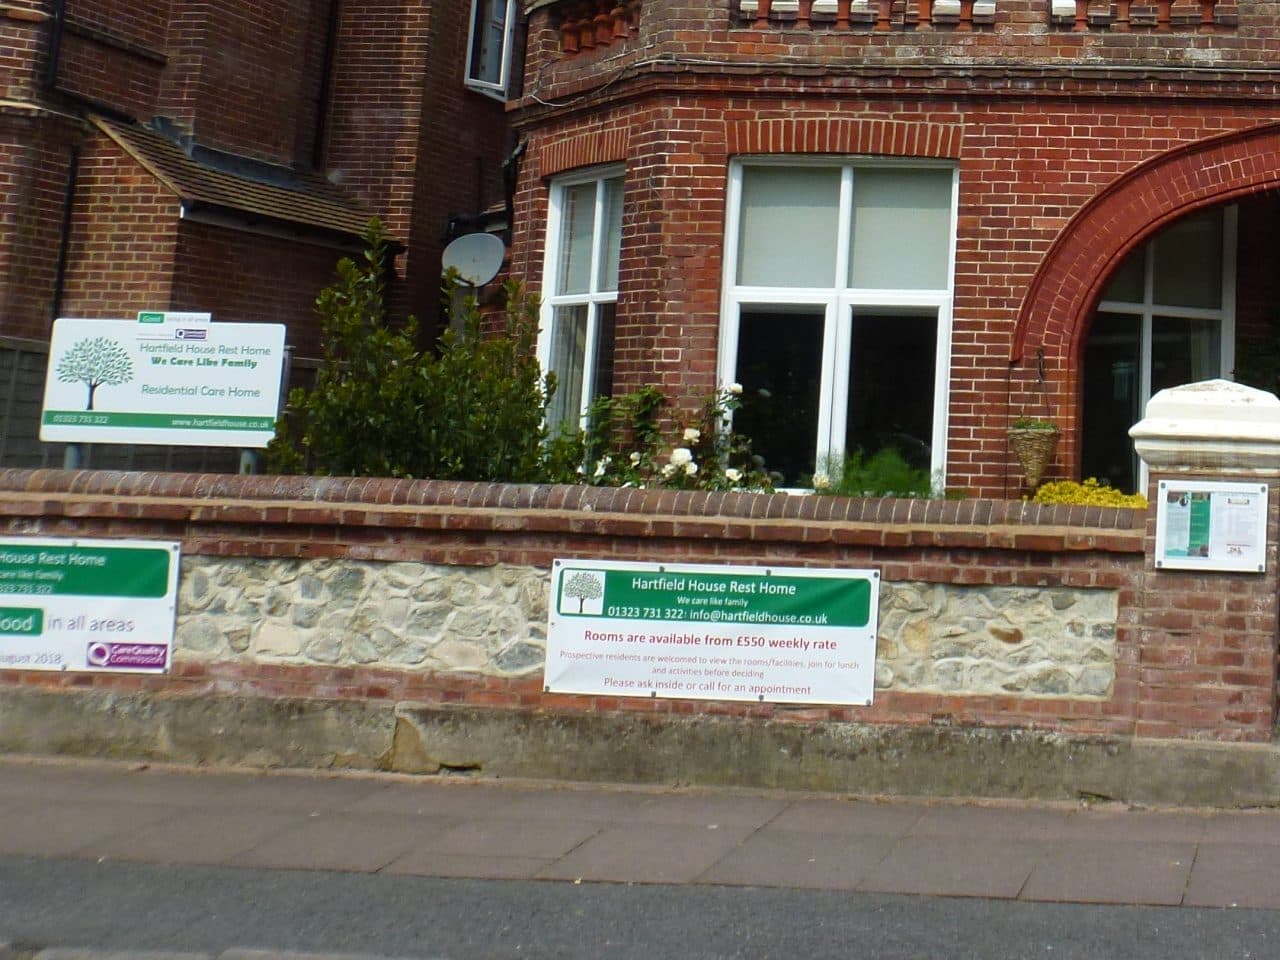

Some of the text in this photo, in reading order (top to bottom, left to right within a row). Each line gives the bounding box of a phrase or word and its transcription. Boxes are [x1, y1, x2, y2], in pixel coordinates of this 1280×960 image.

[140, 343, 271, 356] Hartfield House Rest Home
[152, 357, 257, 369] We Care Like Family
[141, 384, 260, 397] Residential Care Home
[38, 552, 66, 565] Rest
[68, 553, 106, 566] Home
[632, 577, 796, 595] Hartfield House Rest Home
[677, 596, 748, 608] We care like family
[608, 606, 640, 617] 01323
[643, 607, 661, 618] 731
[690, 609, 828, 625] info@hartfieldhouse.co.uk
[0, 615, 135, 632] ood in all areas
[584, 630, 837, 652] Rooms are available from £550 weekly rate
[560, 650, 603, 661] Prospective
[606, 653, 641, 662] residents
[657, 654, 697, 664] welcomed
[699, 656, 707, 664] to
[709, 657, 727, 665] view
[729, 657, 742, 665] the
[808, 660, 822, 669] join
[824, 660, 835, 669] for
[837, 660, 859, 669] lunch
[652, 666, 764, 679] and activities before deciding
[604, 677, 635, 688] Please
[637, 679, 653, 688] ask
[656, 680, 683, 690] inside
[699, 682, 715, 691] call
[718, 682, 731, 692] for
[749, 683, 811, 695] appointment
